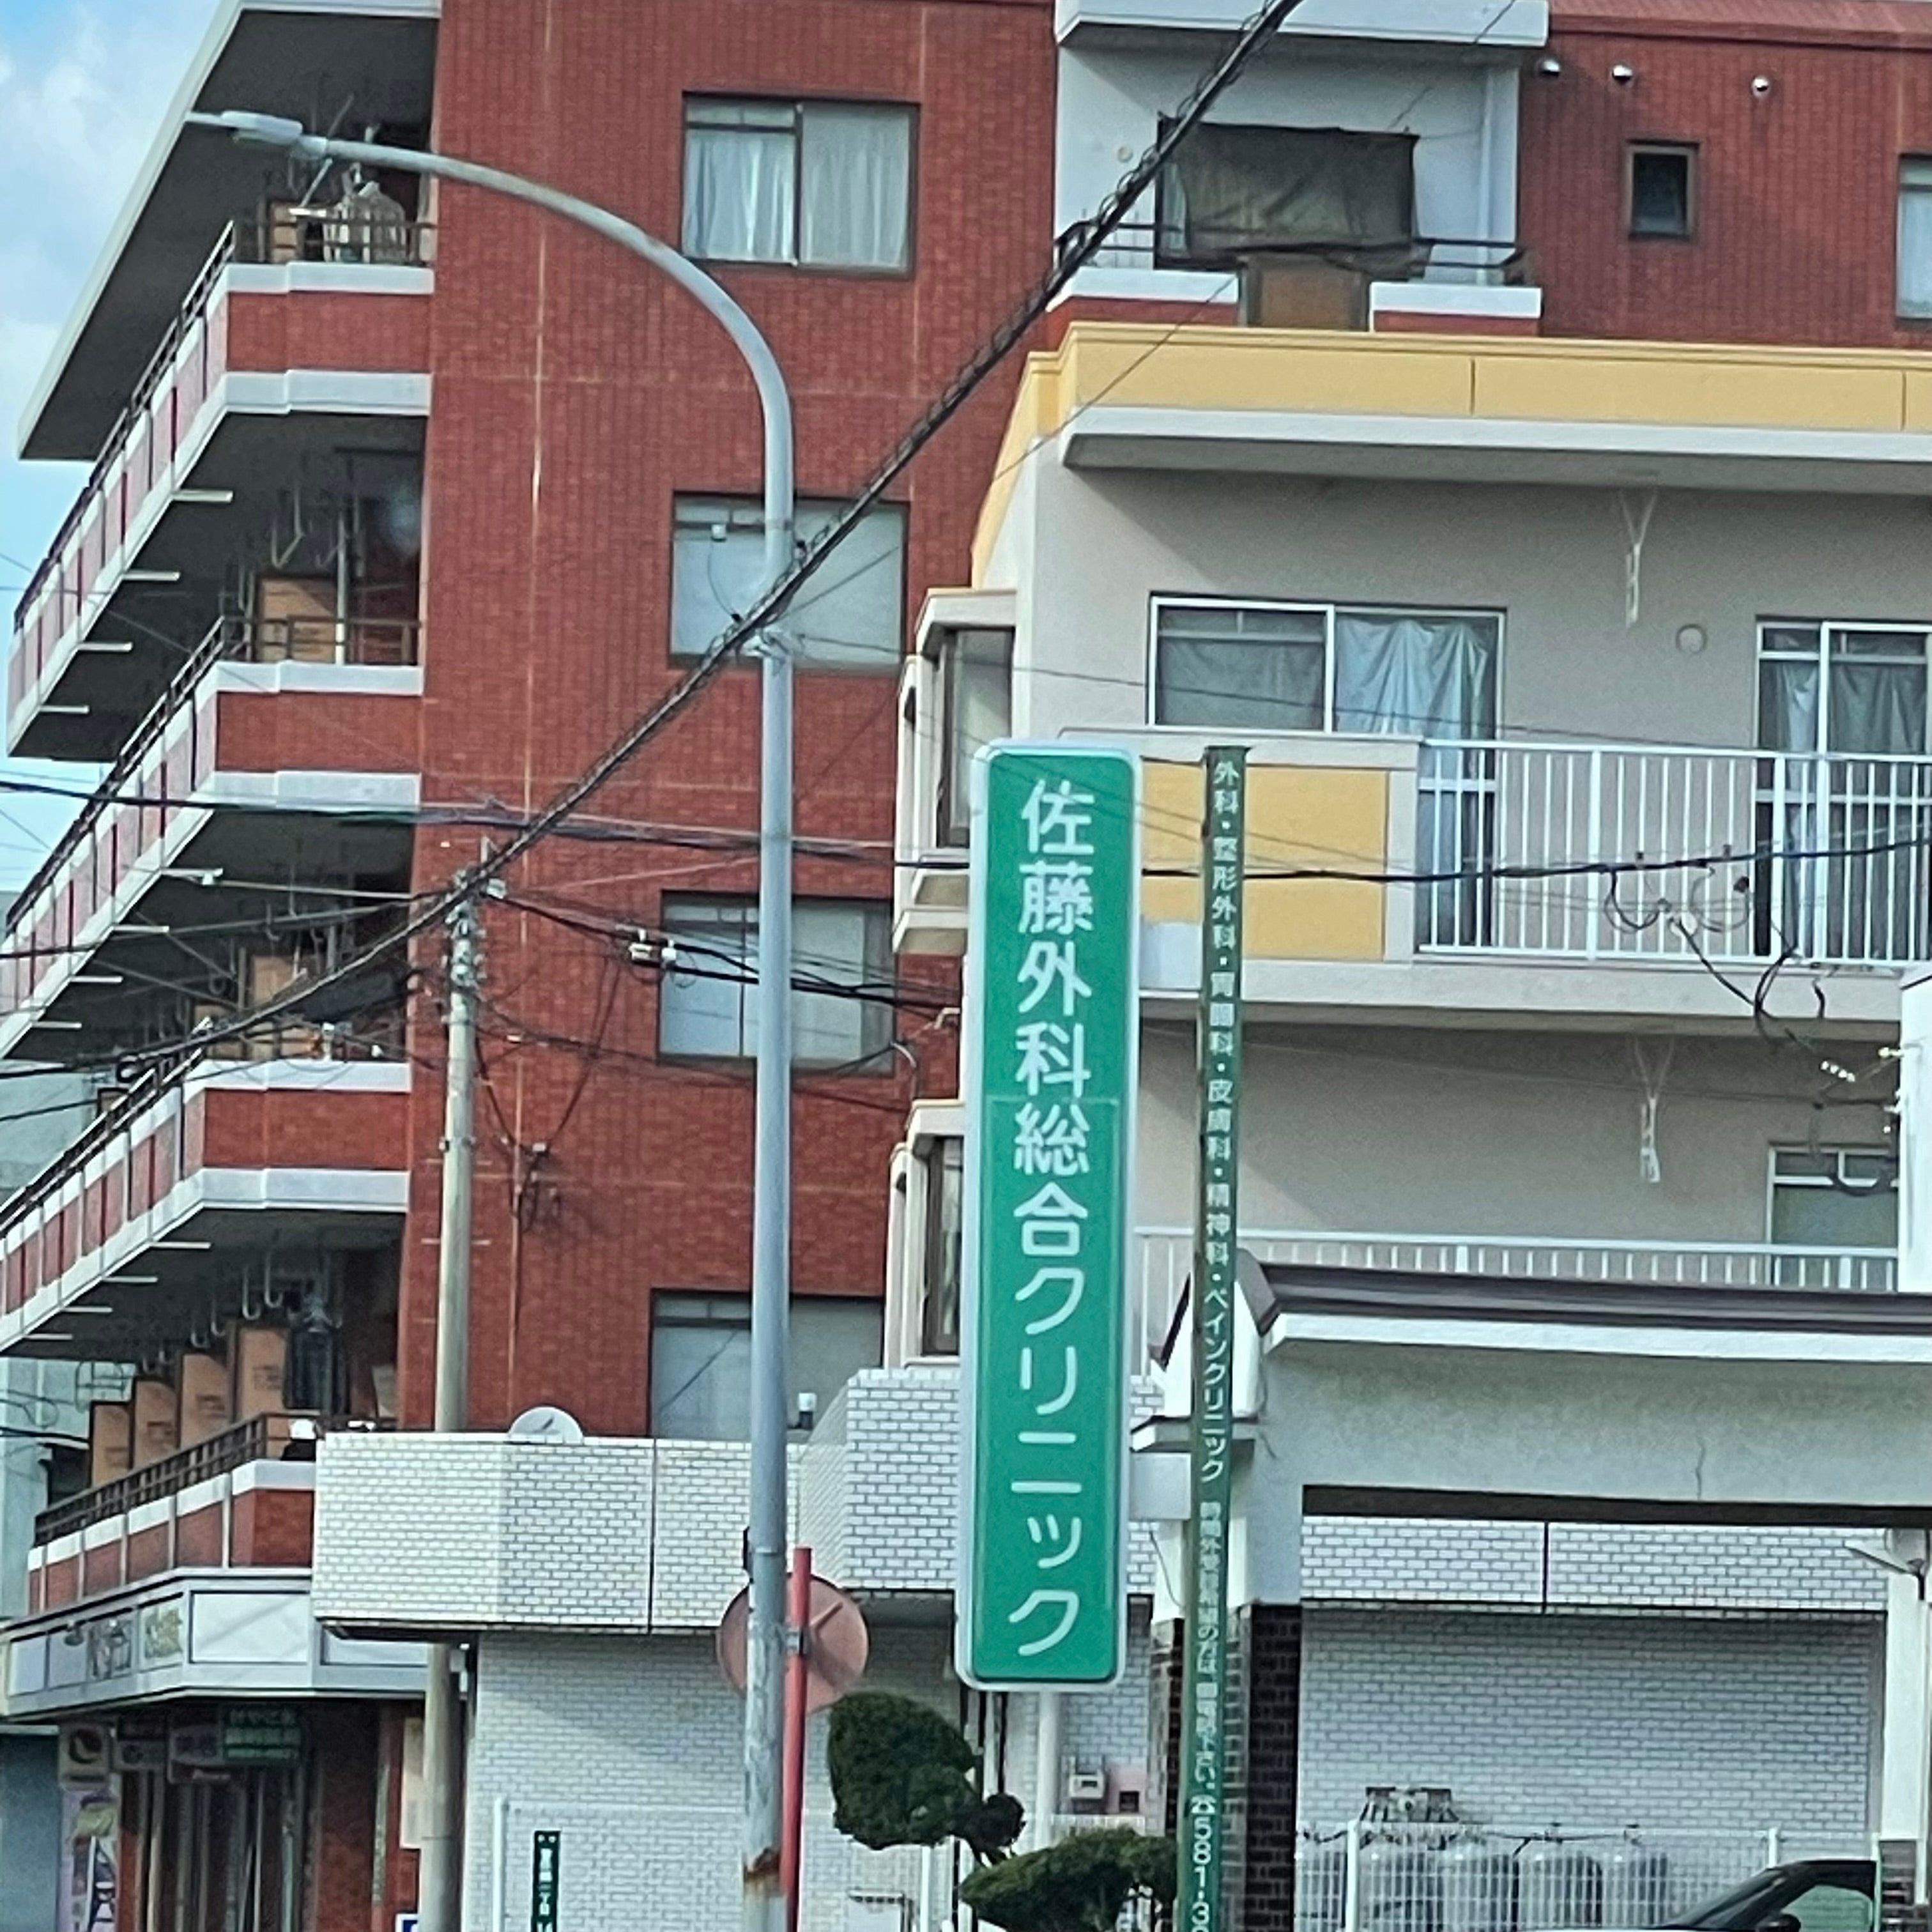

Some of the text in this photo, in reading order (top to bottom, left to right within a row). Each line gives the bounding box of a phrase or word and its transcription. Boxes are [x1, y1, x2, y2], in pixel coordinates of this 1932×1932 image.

[1009, 779, 1096, 1657] 佐藤外科総合クリニック
